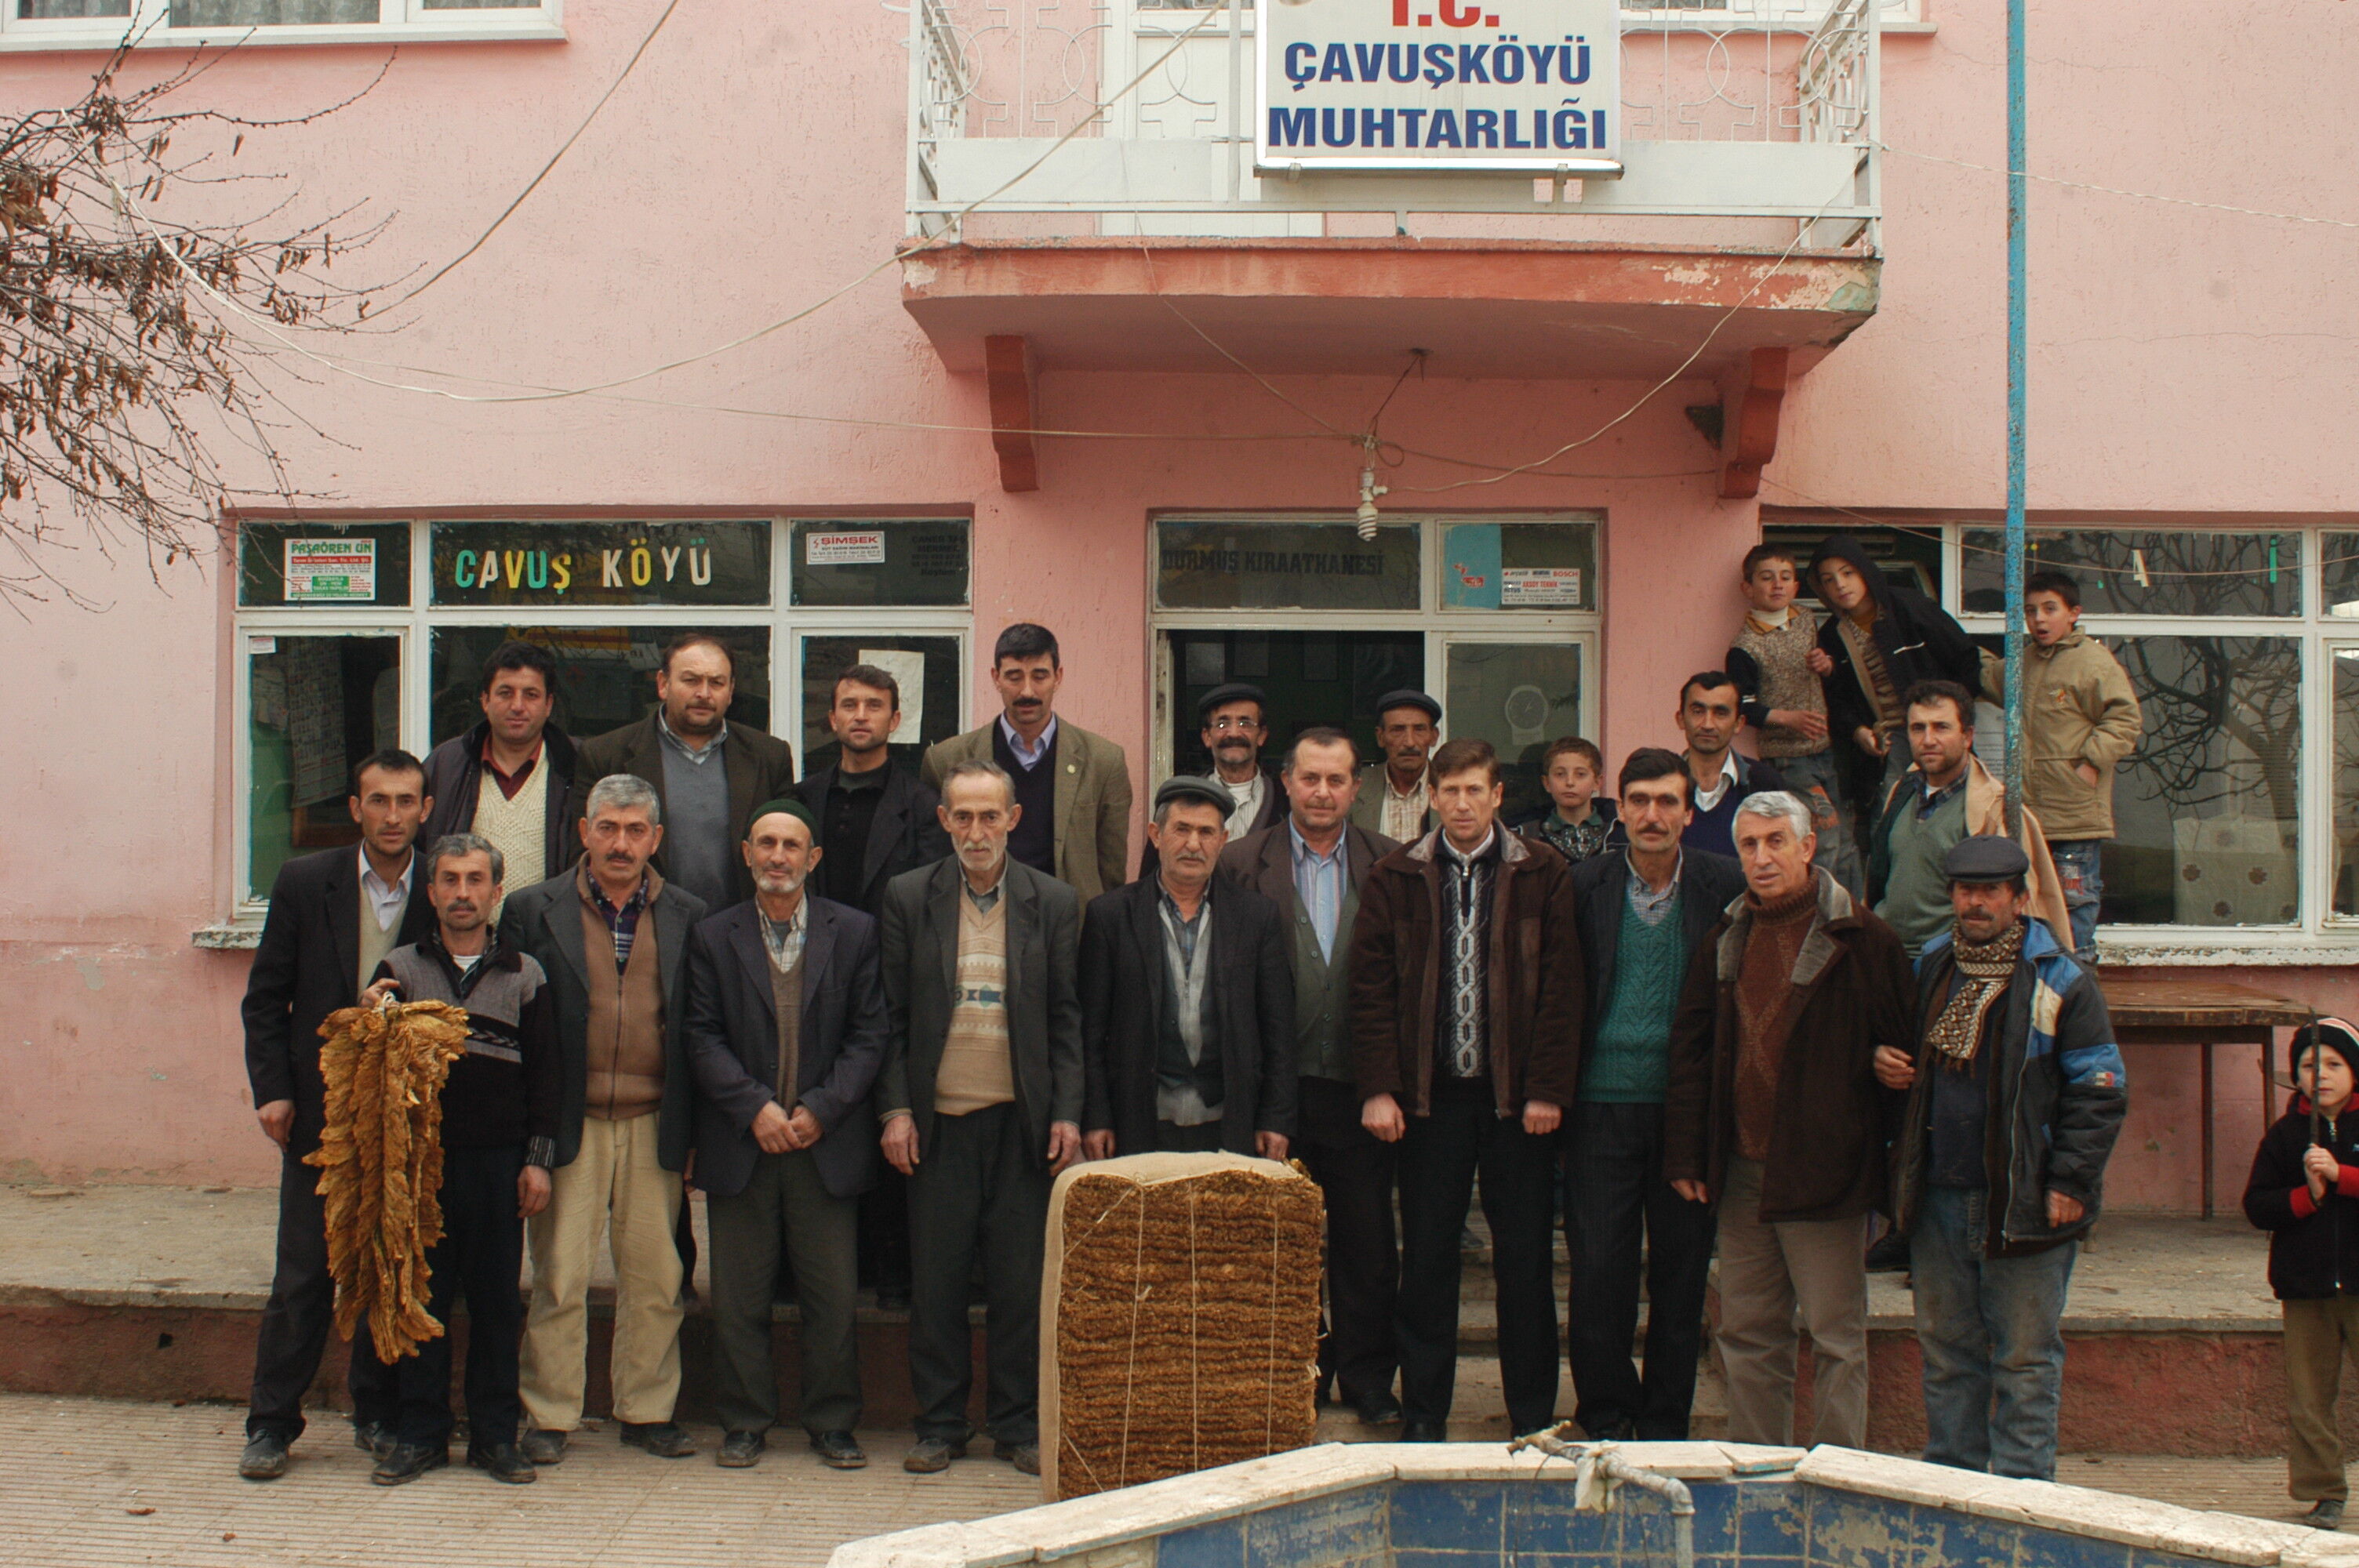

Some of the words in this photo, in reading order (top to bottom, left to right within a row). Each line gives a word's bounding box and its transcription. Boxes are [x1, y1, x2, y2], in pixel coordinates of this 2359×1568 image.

[1285, 35, 1591, 91] ÇAVUŞKÖYÜ
[1268, 98, 1606, 149] MUHTARLIĞI
[602, 538, 712, 588] KÖYÜ
[821, 535, 878, 546] ŞİMŞEK
